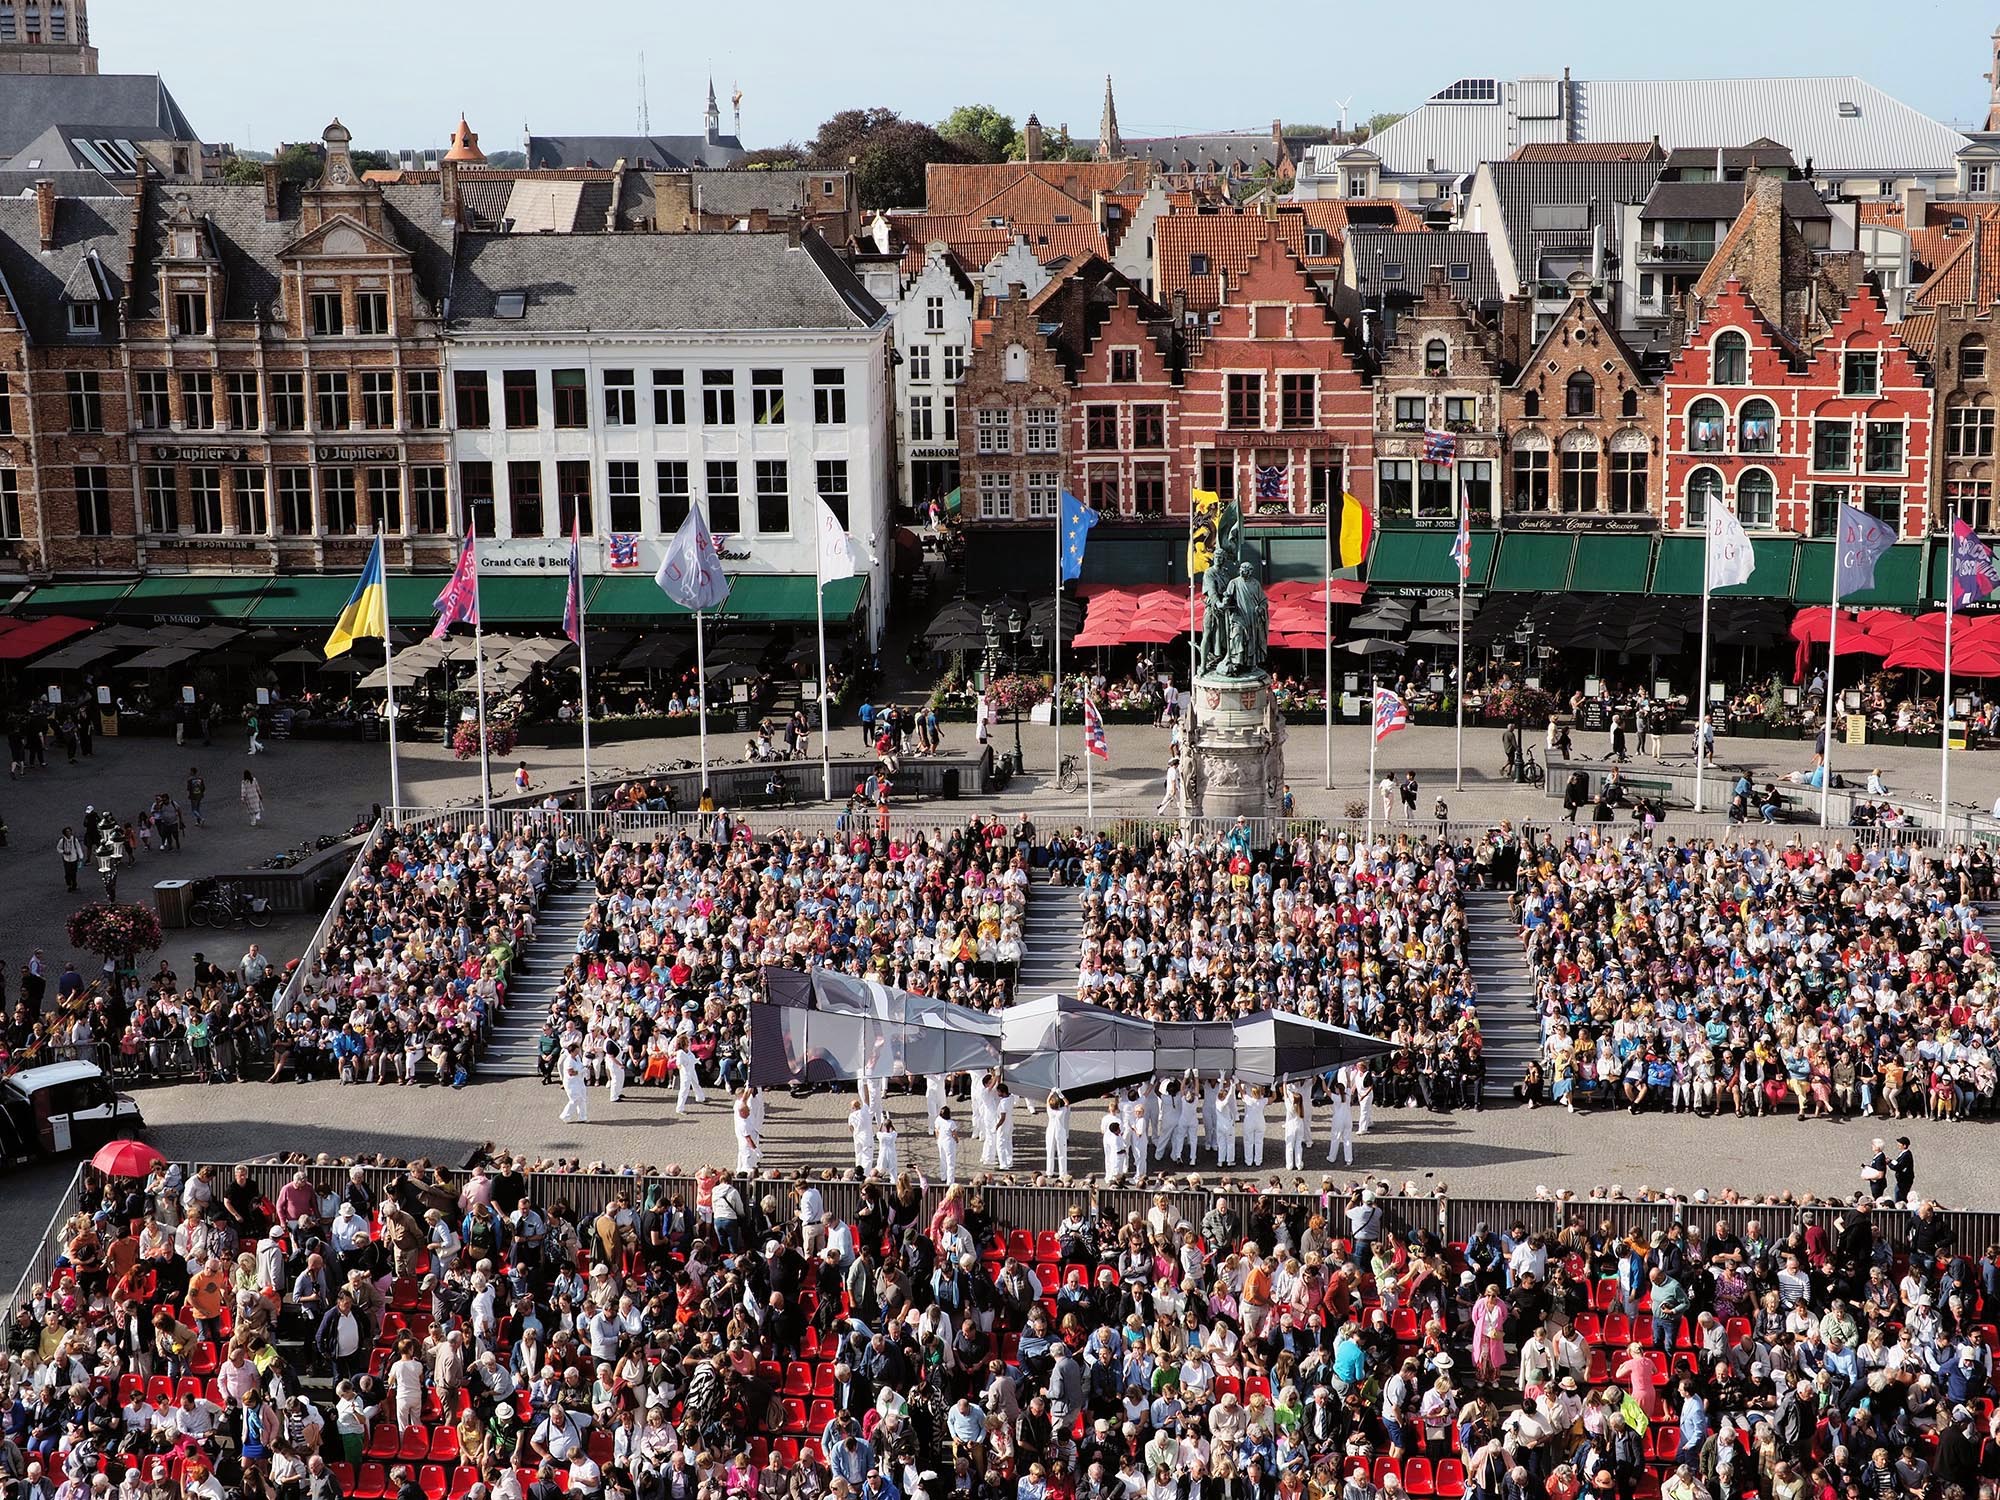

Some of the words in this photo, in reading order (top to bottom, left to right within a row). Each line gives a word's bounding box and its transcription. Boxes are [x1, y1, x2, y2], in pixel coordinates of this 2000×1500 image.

[174, 446, 225, 461] Jupiler
[332, 446, 383, 461] Jupiler
[911, 448, 960, 457] AMBIORI
[1415, 520, 1433, 528] SINT
[1434, 520, 1456, 528] JORIS
[481, 557, 511, 567] Grand
[514, 557, 535, 567] Café
[549, 557, 571, 567] Belfo
[1399, 588, 1455, 597] SINT-JORIS
[153, 615, 166, 623] DA
[169, 615, 201, 623] MARIO
